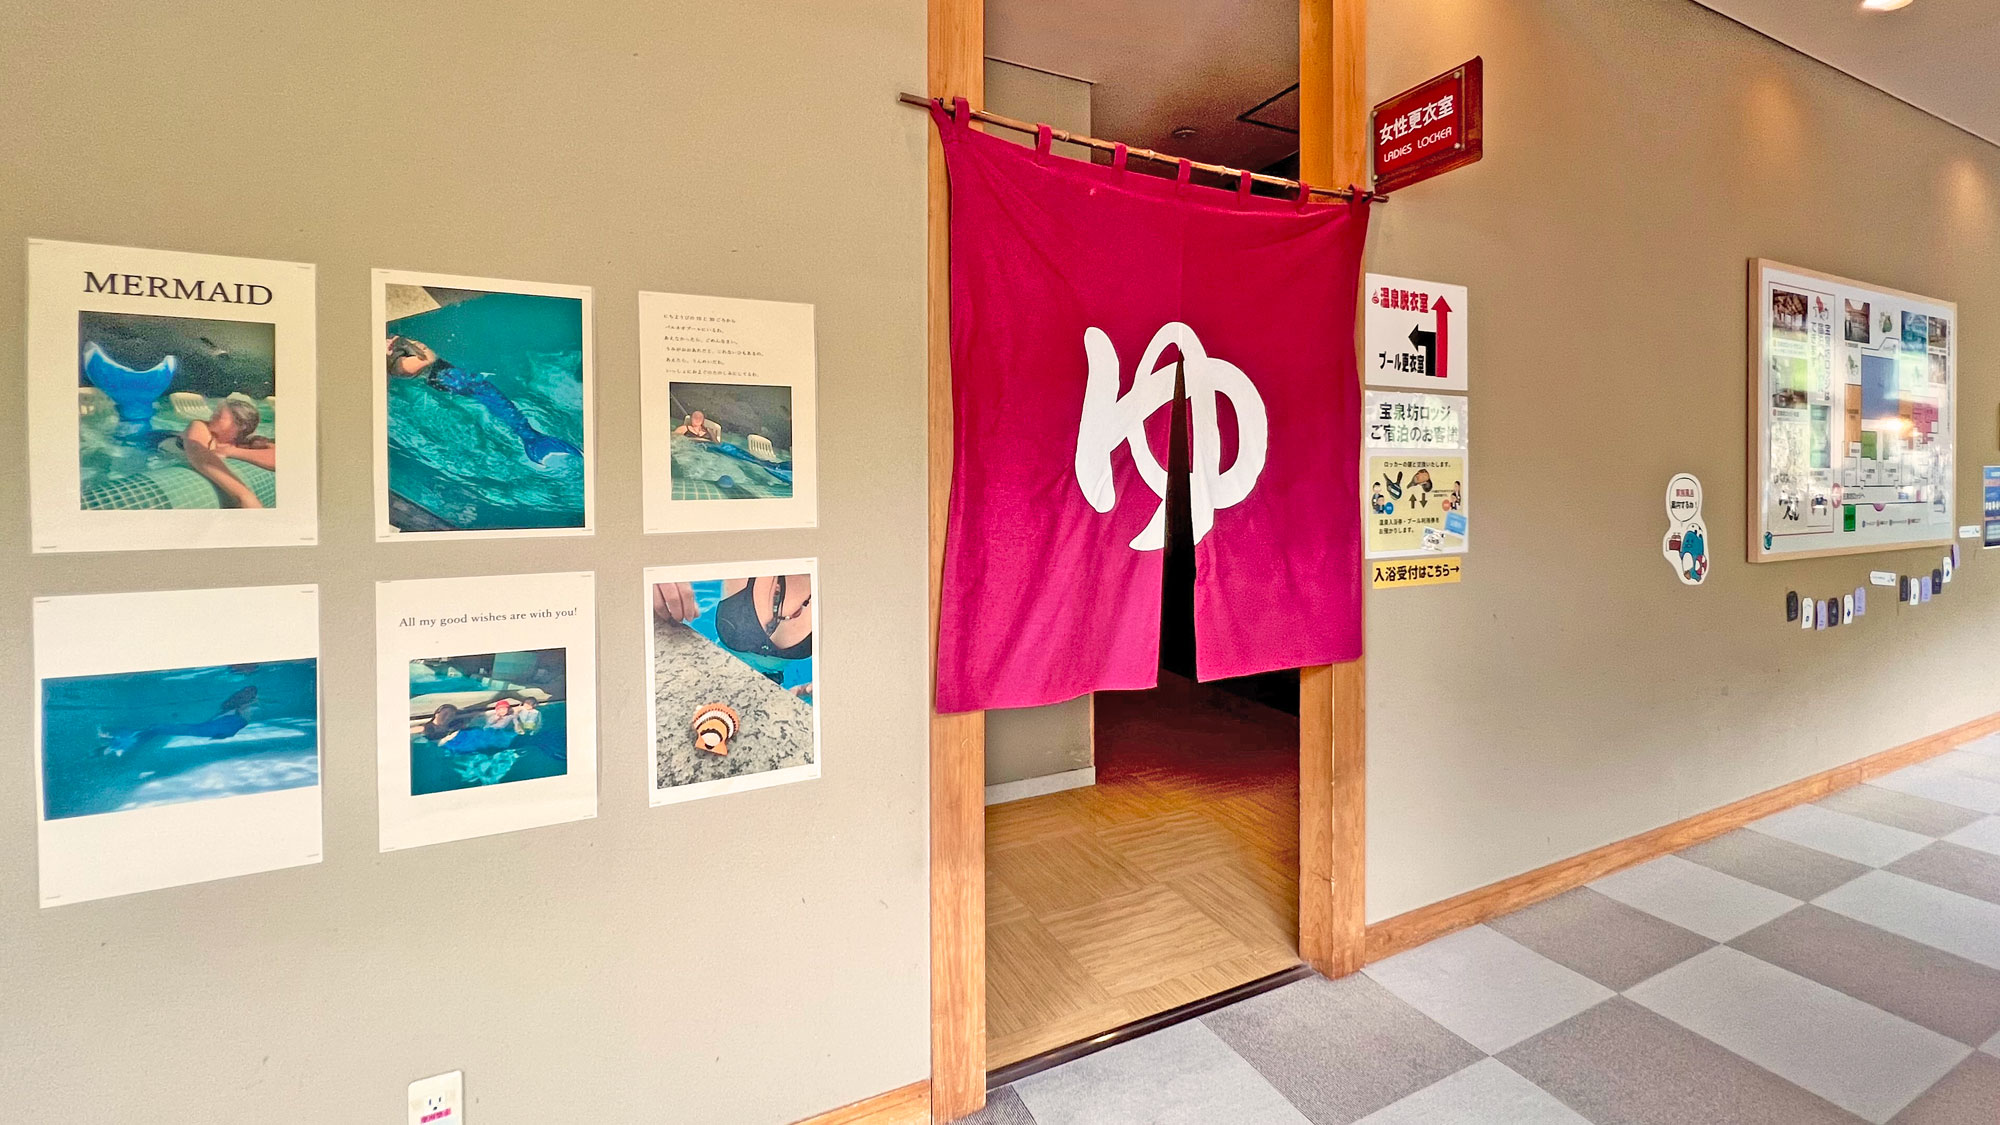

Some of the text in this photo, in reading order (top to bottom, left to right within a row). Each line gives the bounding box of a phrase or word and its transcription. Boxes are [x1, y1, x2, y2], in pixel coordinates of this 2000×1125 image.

[1379, 95, 1454, 145] 女性更衣室
[1383, 126, 1453, 163] LADIES LOCKER
[83, 271, 273, 306] MERMAID
[1380, 287, 1429, 314] 温泉脱衣室
[1378, 350, 1425, 374] プール更衣室
[1379, 402, 1451, 421] 宝泉坊ロッジ
[1075, 321, 1268, 551] ゆ
[1374, 564, 1450, 582] 入浴受付はこちら
[399, 607, 577, 628] All my good wishes are with you!
